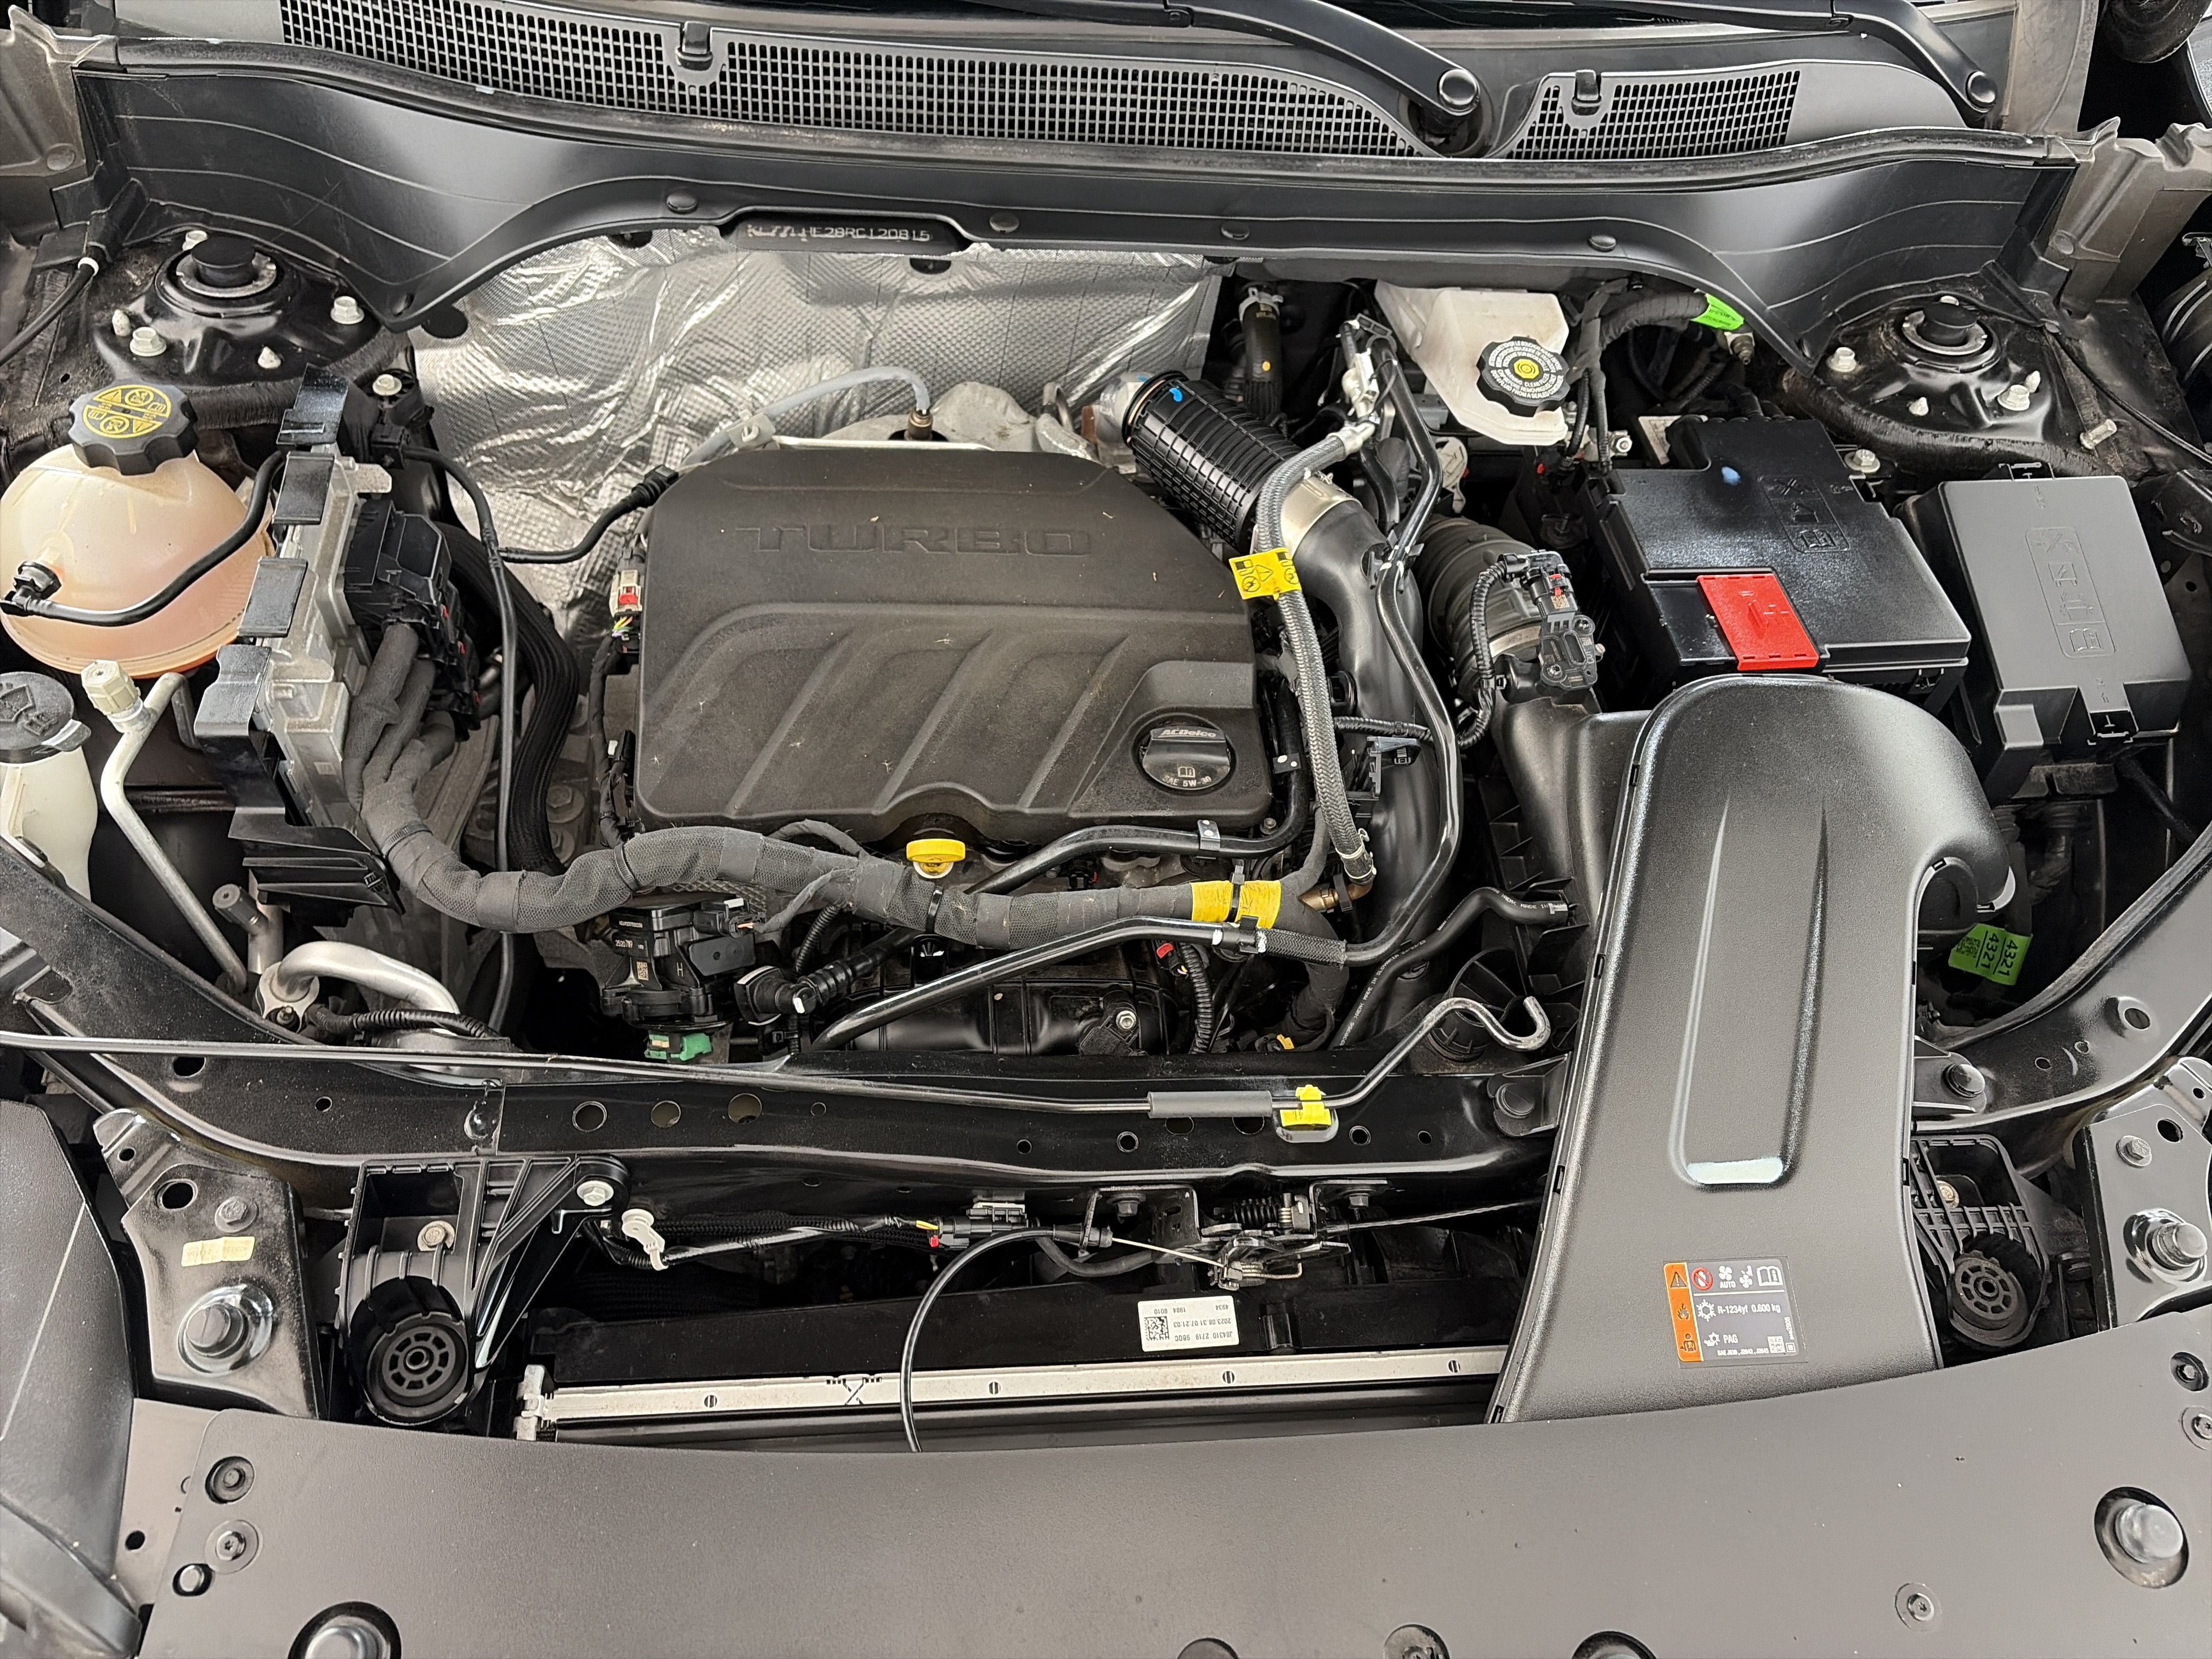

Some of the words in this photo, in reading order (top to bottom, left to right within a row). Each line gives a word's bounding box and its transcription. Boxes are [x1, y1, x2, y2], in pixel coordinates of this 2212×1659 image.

[735, 522, 1092, 557] TURBO
[1160, 729, 1217, 738] ACDelco
[1162, 774, 1179, 787] SAE
[1183, 776, 1211, 787] 5W-30
[1980, 933, 2000, 969] 4321
[1997, 939, 2018, 977] 4321
[1363, 986, 1373, 1001] MADE
[1376, 954, 1400, 976] SLOVAKIA
[1719, 1280, 1736, 1289] AUTO
[1717, 1305, 1748, 1316] R-1234yf
[1771, 1303, 1781, 1314] kg
[1723, 1334, 1739, 1344] PAG
